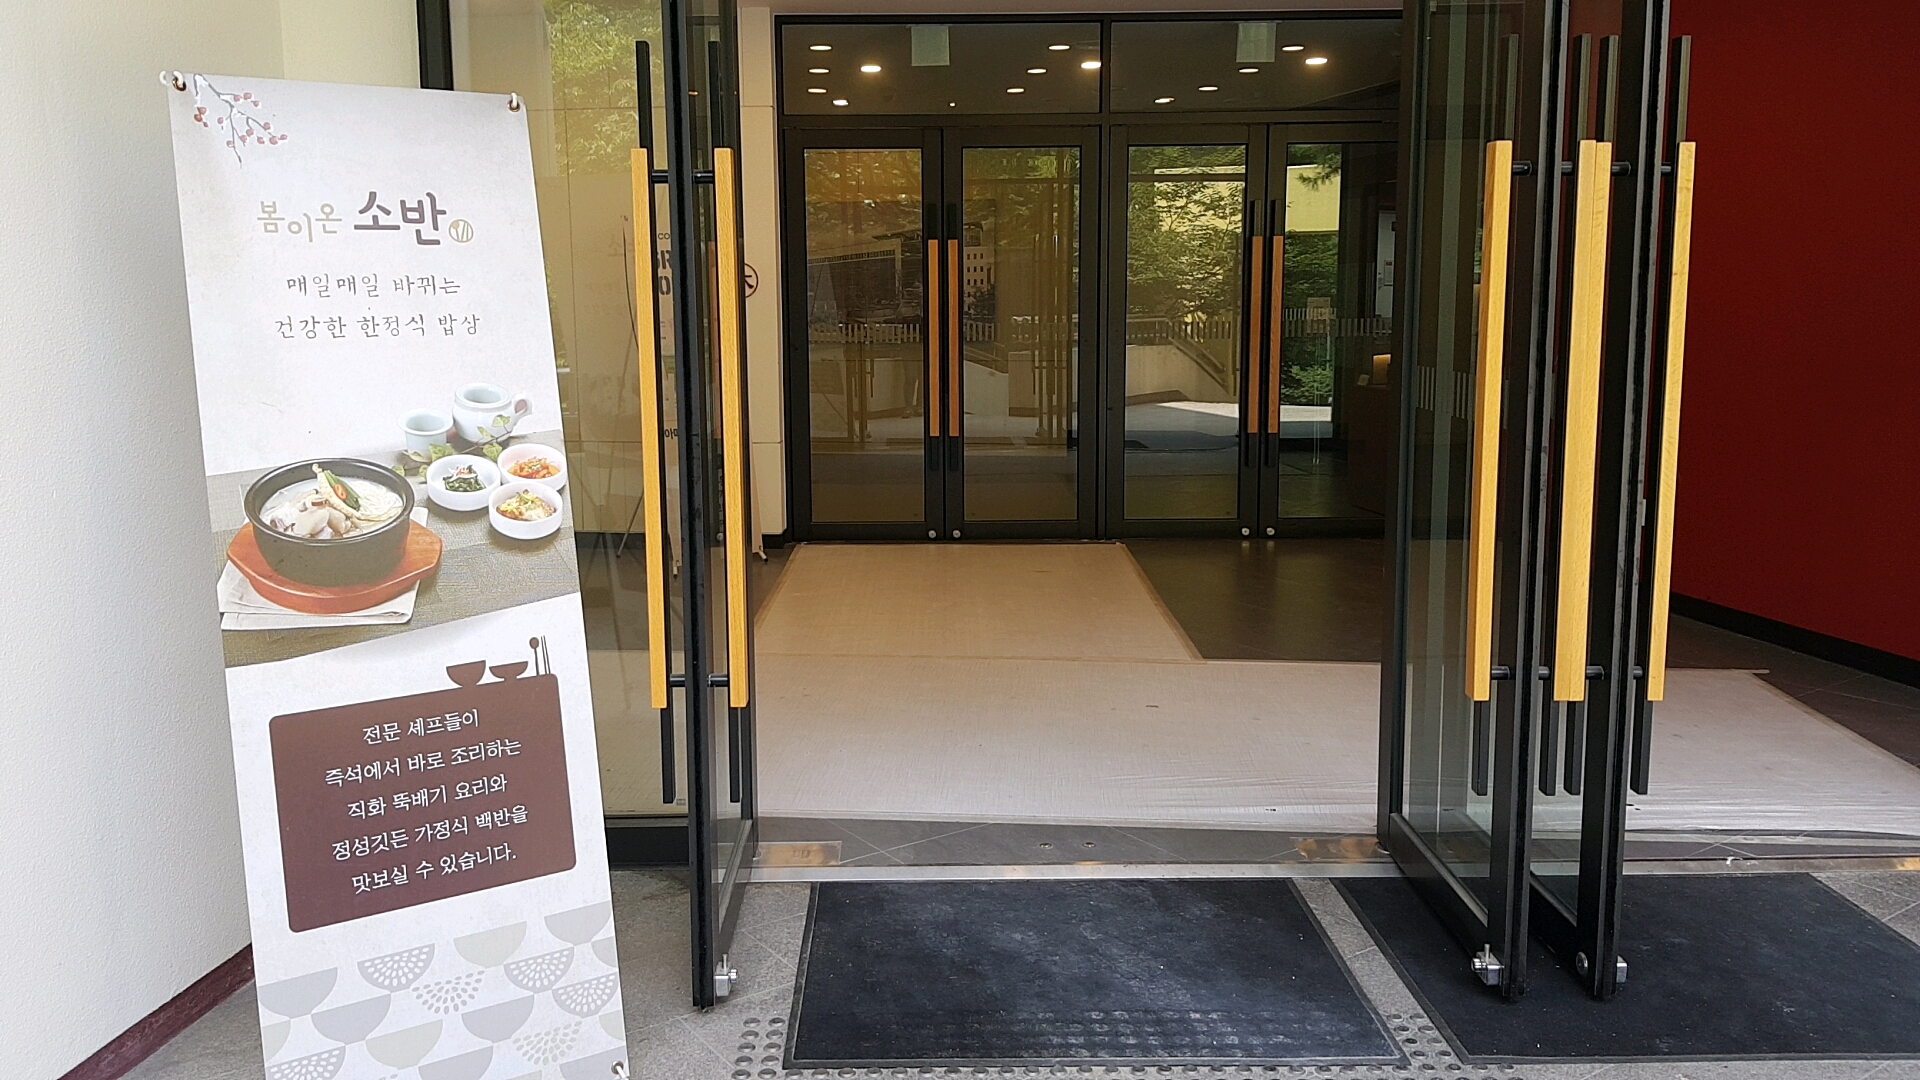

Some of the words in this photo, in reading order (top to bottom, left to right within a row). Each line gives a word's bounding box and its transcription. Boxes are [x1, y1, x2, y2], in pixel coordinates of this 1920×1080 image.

[353, 190, 448, 246] 소반
[286, 272, 380, 299] 매일매일
[392, 274, 461, 297] 바뀌는
[274, 314, 347, 340] 건강한
[356, 313, 425, 339] 한정식
[437, 312, 481, 337] 밥상
[362, 722, 402, 745] 전문
[407, 708, 479, 737] 셰프들이
[324, 757, 400, 788] 즉석에서
[406, 751, 446, 773] 바로
[450, 738, 522, 765] 조리하는
[347, 796, 387, 820] 직화
[392, 784, 447, 811] 뚝배기
[454, 773, 508, 800] 요리와
[331, 828, 410, 861] 정성깃든
[414, 815, 468, 843] 가정식
[474, 804, 529, 830] 백반을
[351, 864, 409, 895] 맛보실
[415, 860, 435, 880] 수
[439, 842, 517, 876] 있습니다.
